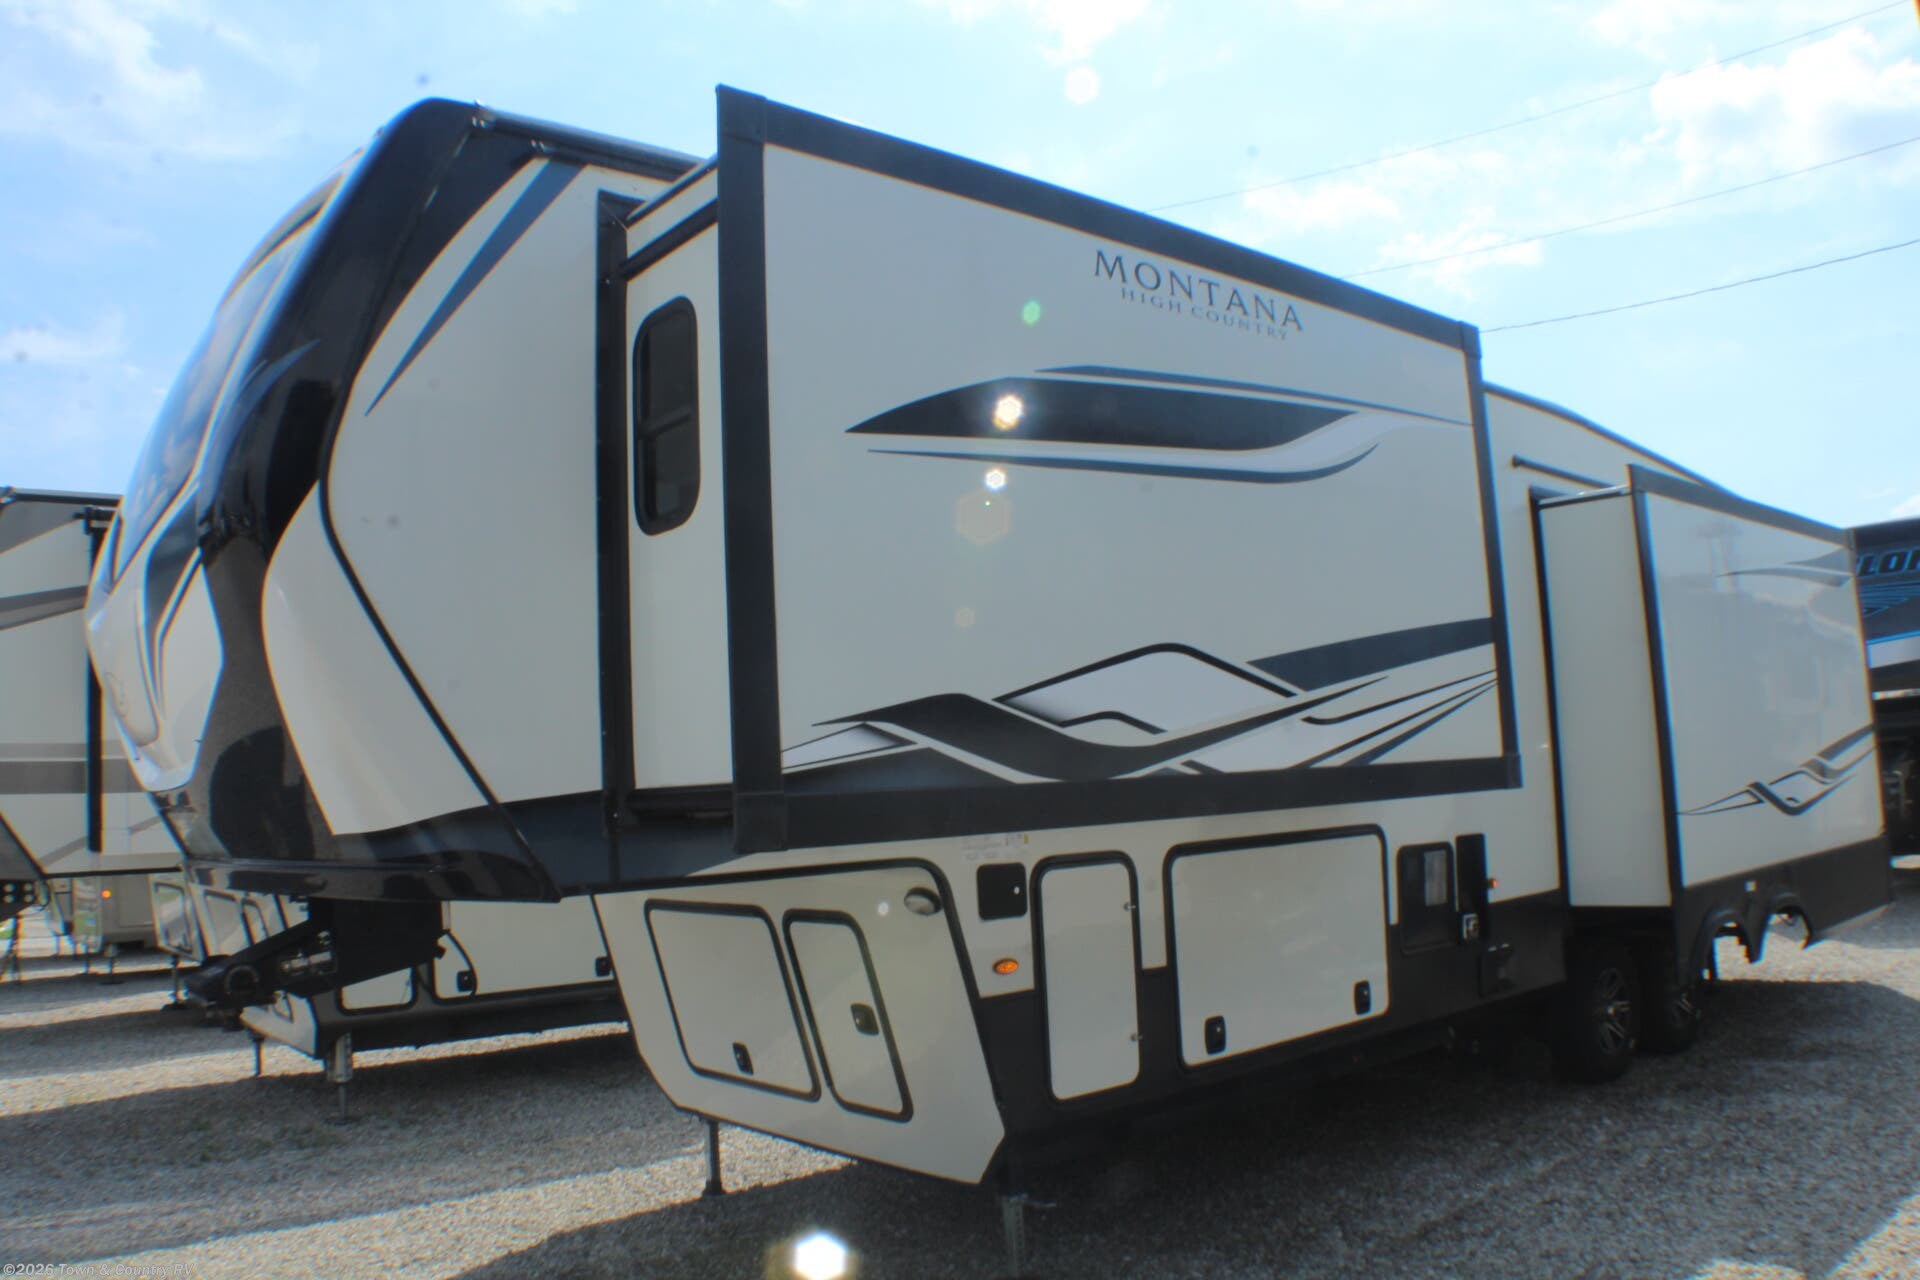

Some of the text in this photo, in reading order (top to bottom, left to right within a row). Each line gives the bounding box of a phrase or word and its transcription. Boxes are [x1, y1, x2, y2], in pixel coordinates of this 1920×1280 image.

[1094, 250, 1303, 332] MONTANA
[1121, 287, 1288, 341] HIGH COUNTRY
